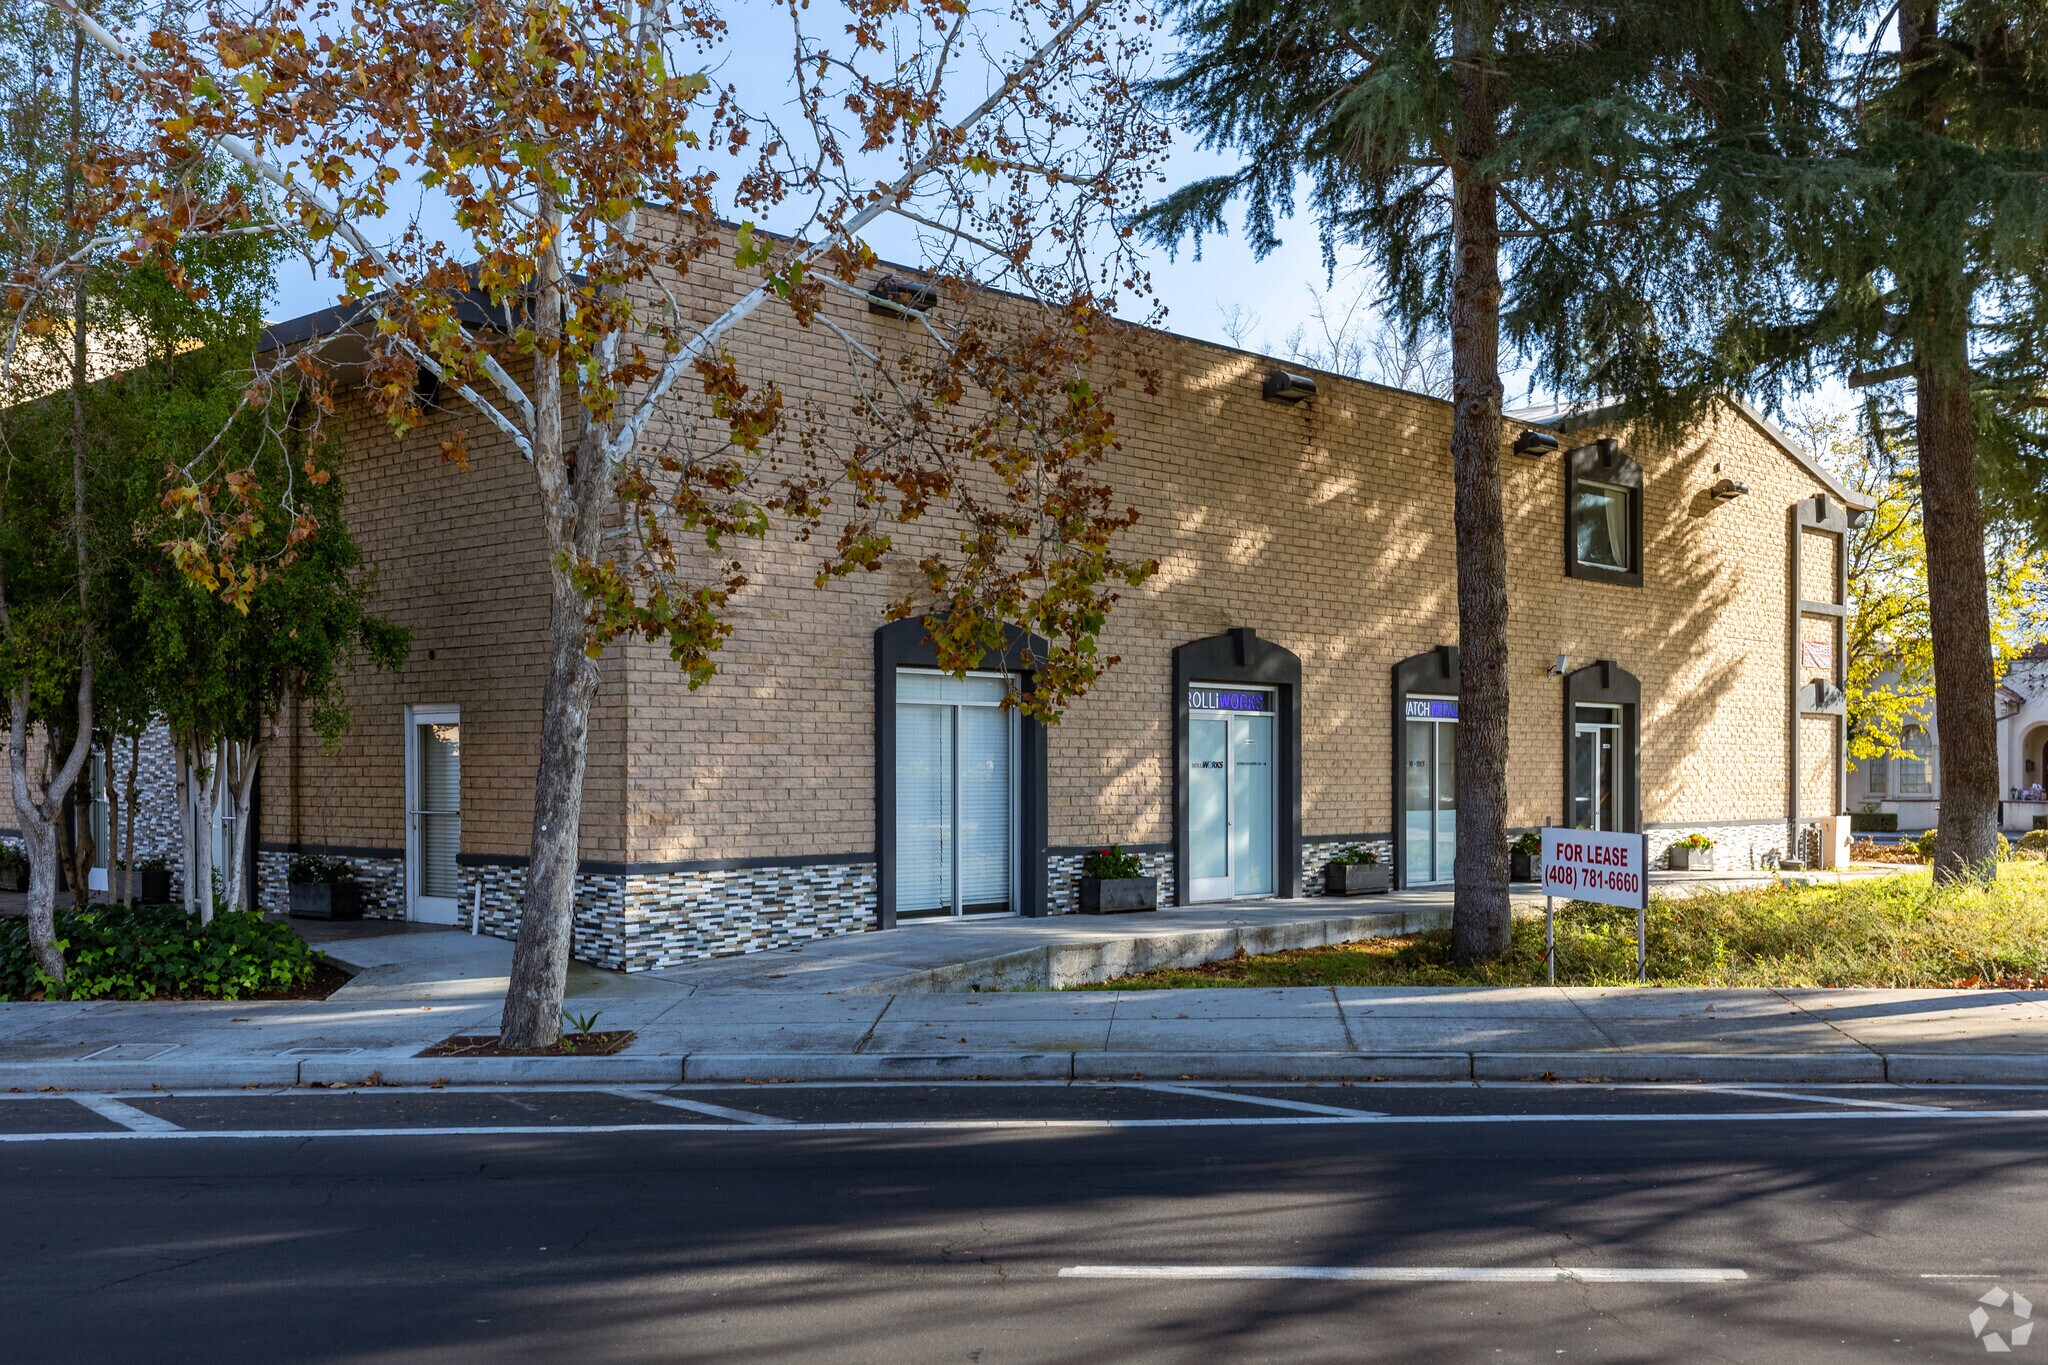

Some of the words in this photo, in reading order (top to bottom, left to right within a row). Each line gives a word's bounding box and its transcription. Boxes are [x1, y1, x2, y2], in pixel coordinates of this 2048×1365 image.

[1406, 701, 1429, 717] ATCH
[1431, 702, 1458, 717] REPAI
[1556, 843, 1583, 862] FOR
[1587, 845, 1628, 867] LEASE
[1545, 864, 1577, 890] (408)
[1581, 868, 1639, 893] 781-6660
